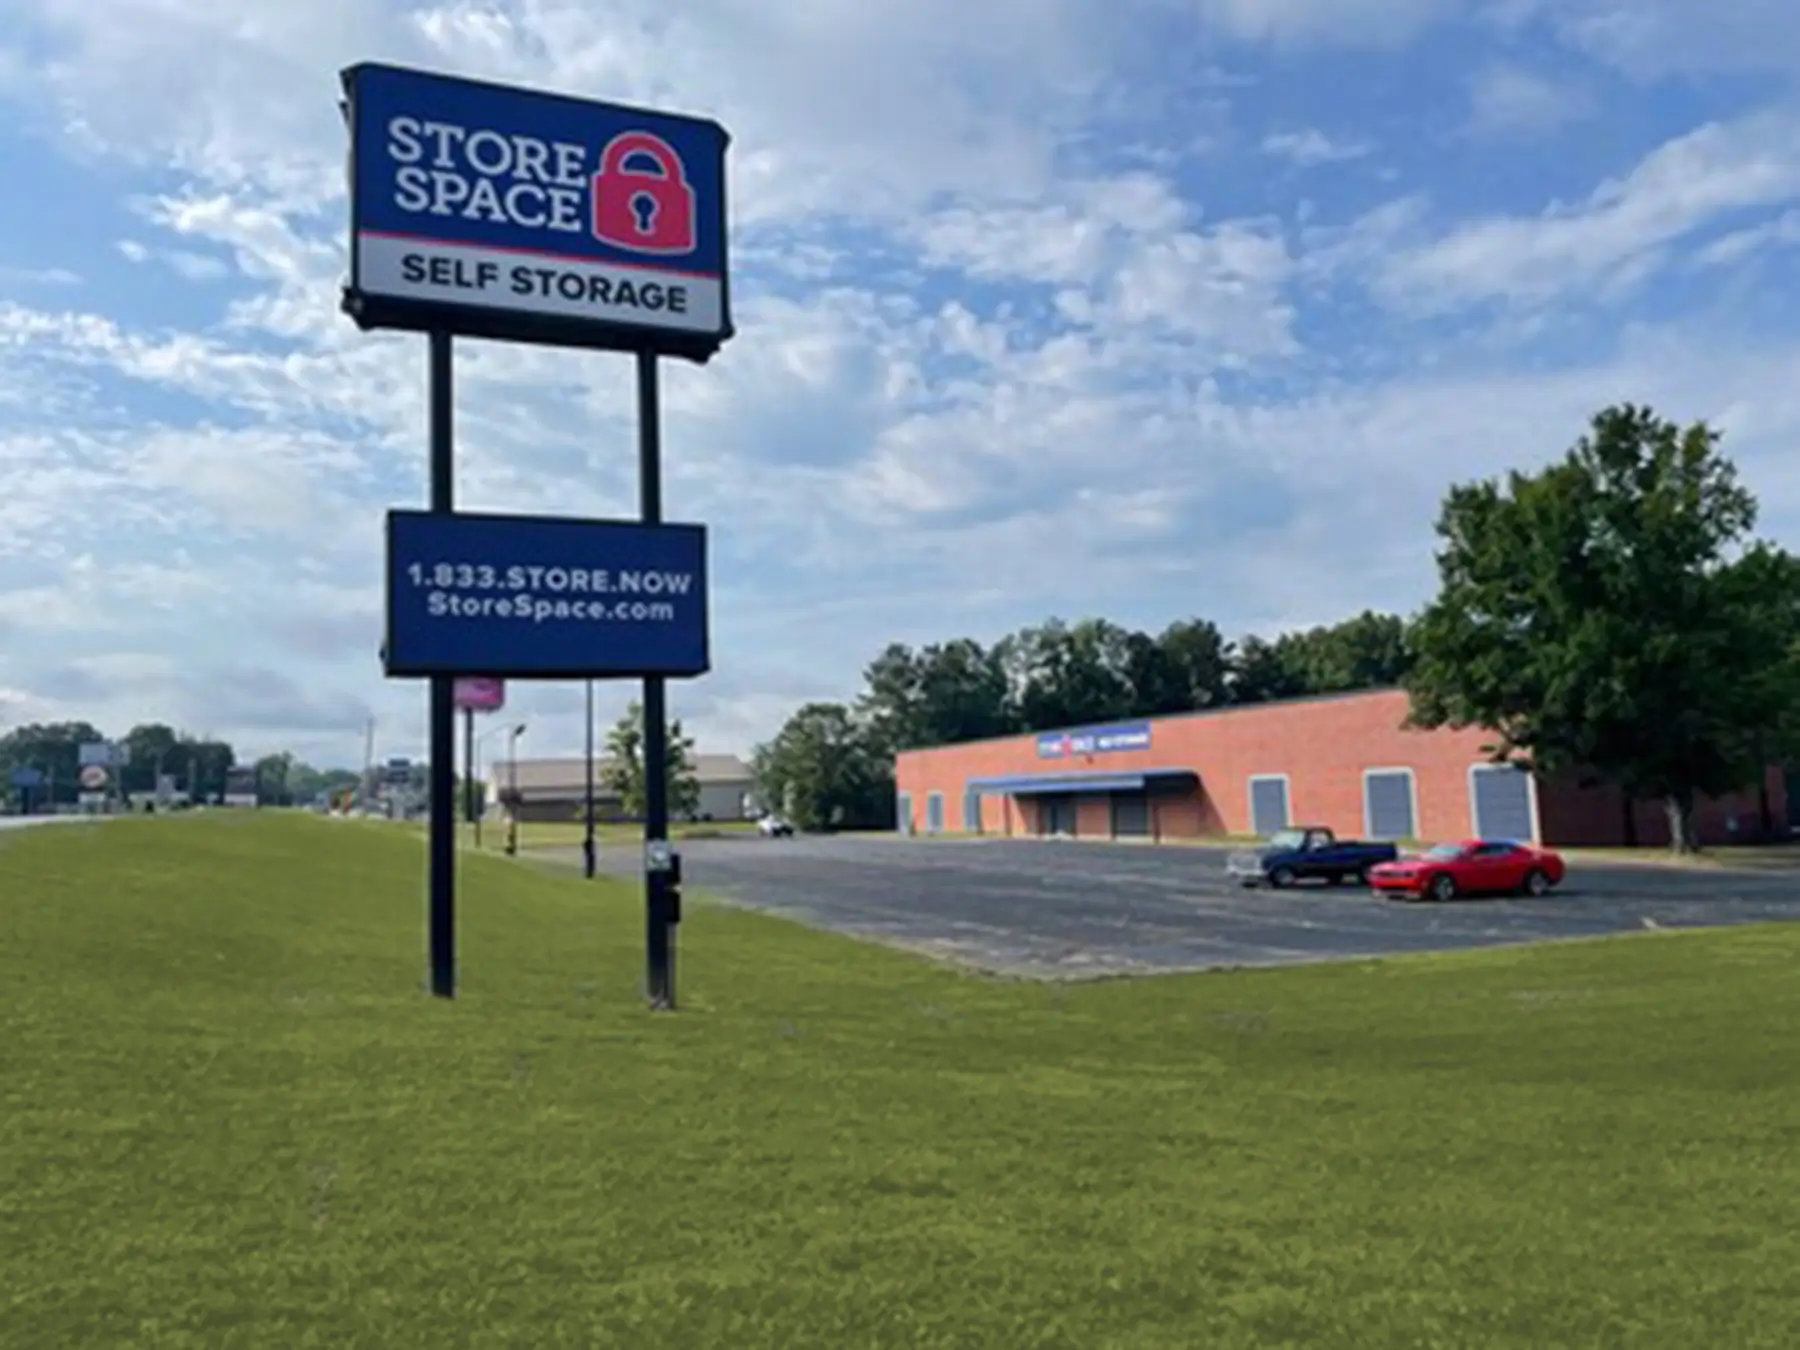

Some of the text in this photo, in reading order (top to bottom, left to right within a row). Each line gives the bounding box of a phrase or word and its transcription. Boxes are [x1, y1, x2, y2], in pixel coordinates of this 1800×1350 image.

[388, 117, 587, 187] STORE
[394, 167, 582, 231] SPACE
[402, 254, 687, 313] SELF STORAGE
[407, 563, 692, 594] 1.833.STORE.NOW
[427, 591, 674, 622] StoreSpace.com
